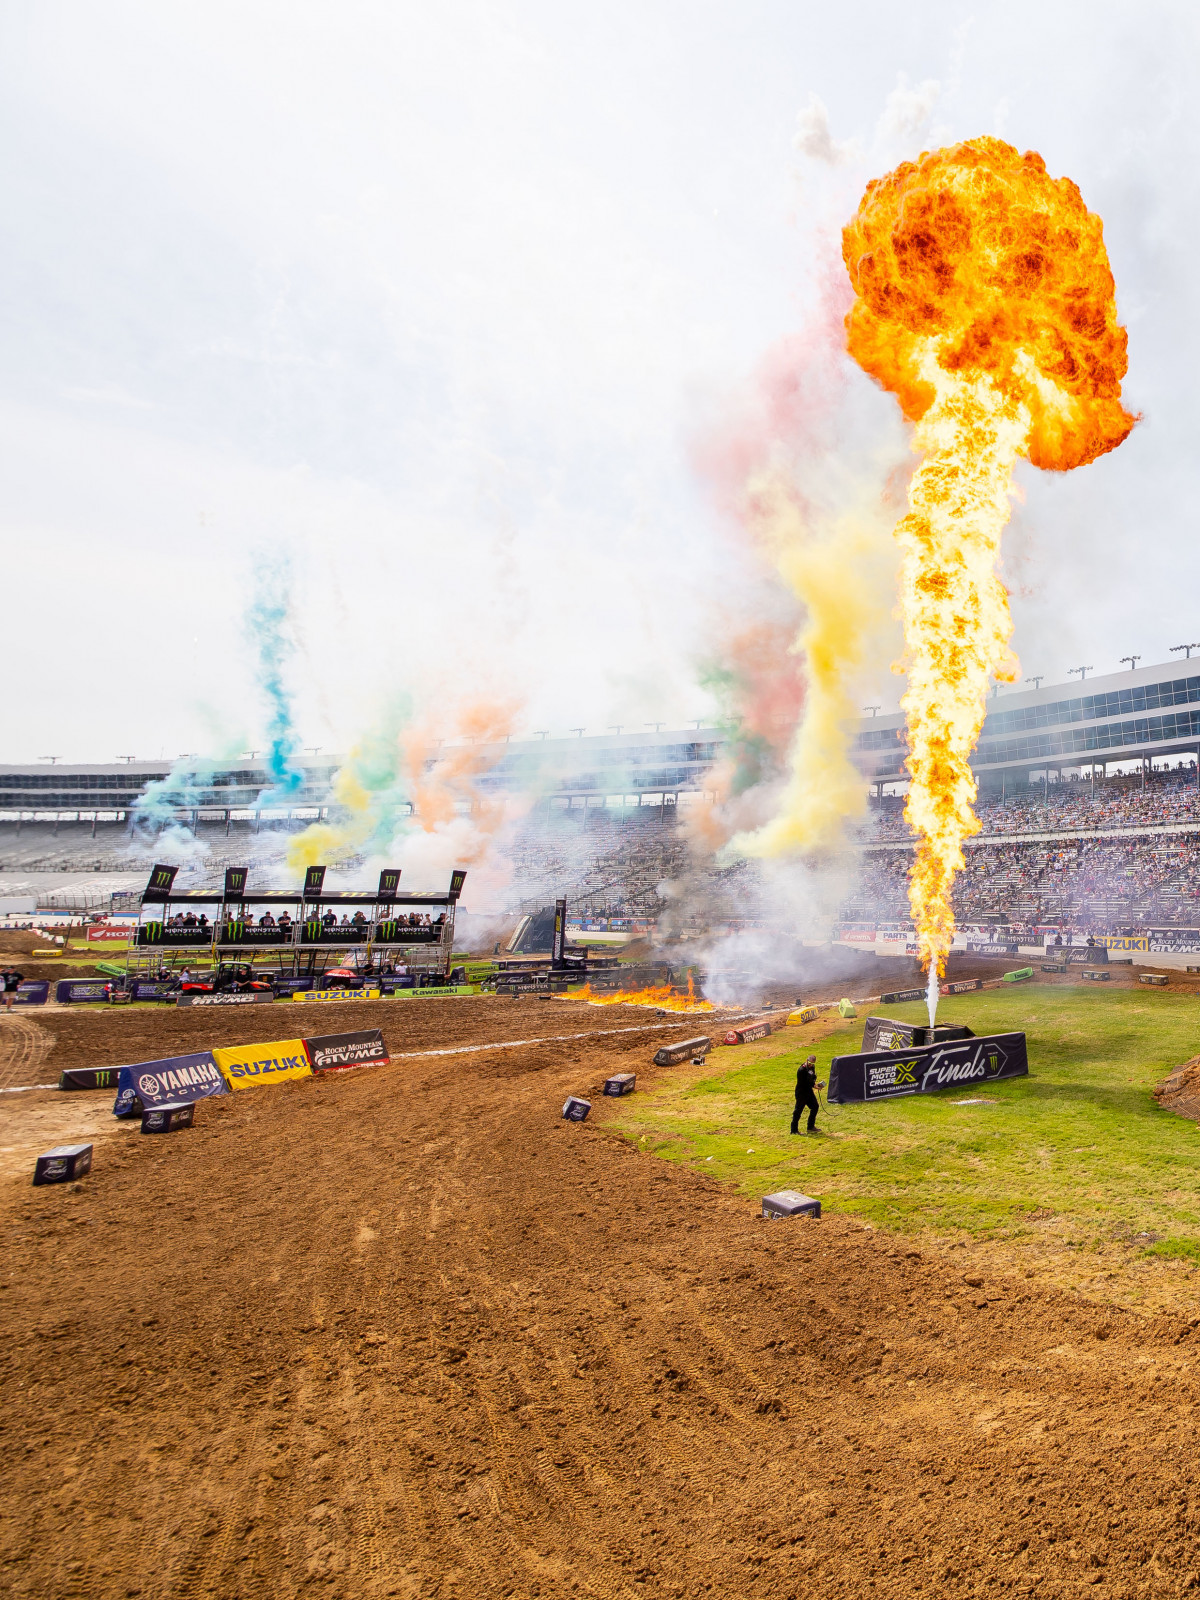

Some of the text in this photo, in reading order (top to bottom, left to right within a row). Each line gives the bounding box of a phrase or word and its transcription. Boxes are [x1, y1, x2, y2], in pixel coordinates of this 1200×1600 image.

[106, 927, 131, 938] HON
[1094, 938, 1146, 951] SUZUKI
[304, 990, 370, 1000] SUZUKI
[412, 988, 458, 996] Kawasaki
[325, 1040, 382, 1056] ROCKY MOUNTAIN
[229, 1055, 308, 1078] SUZUKI
[869, 1066, 897, 1075] SUPER
[921, 1044, 986, 1091] Finals
[156, 1062, 221, 1091] YAMAHA
[869, 1077, 897, 1086] CROSS
[152, 1082, 221, 1101] RACING
